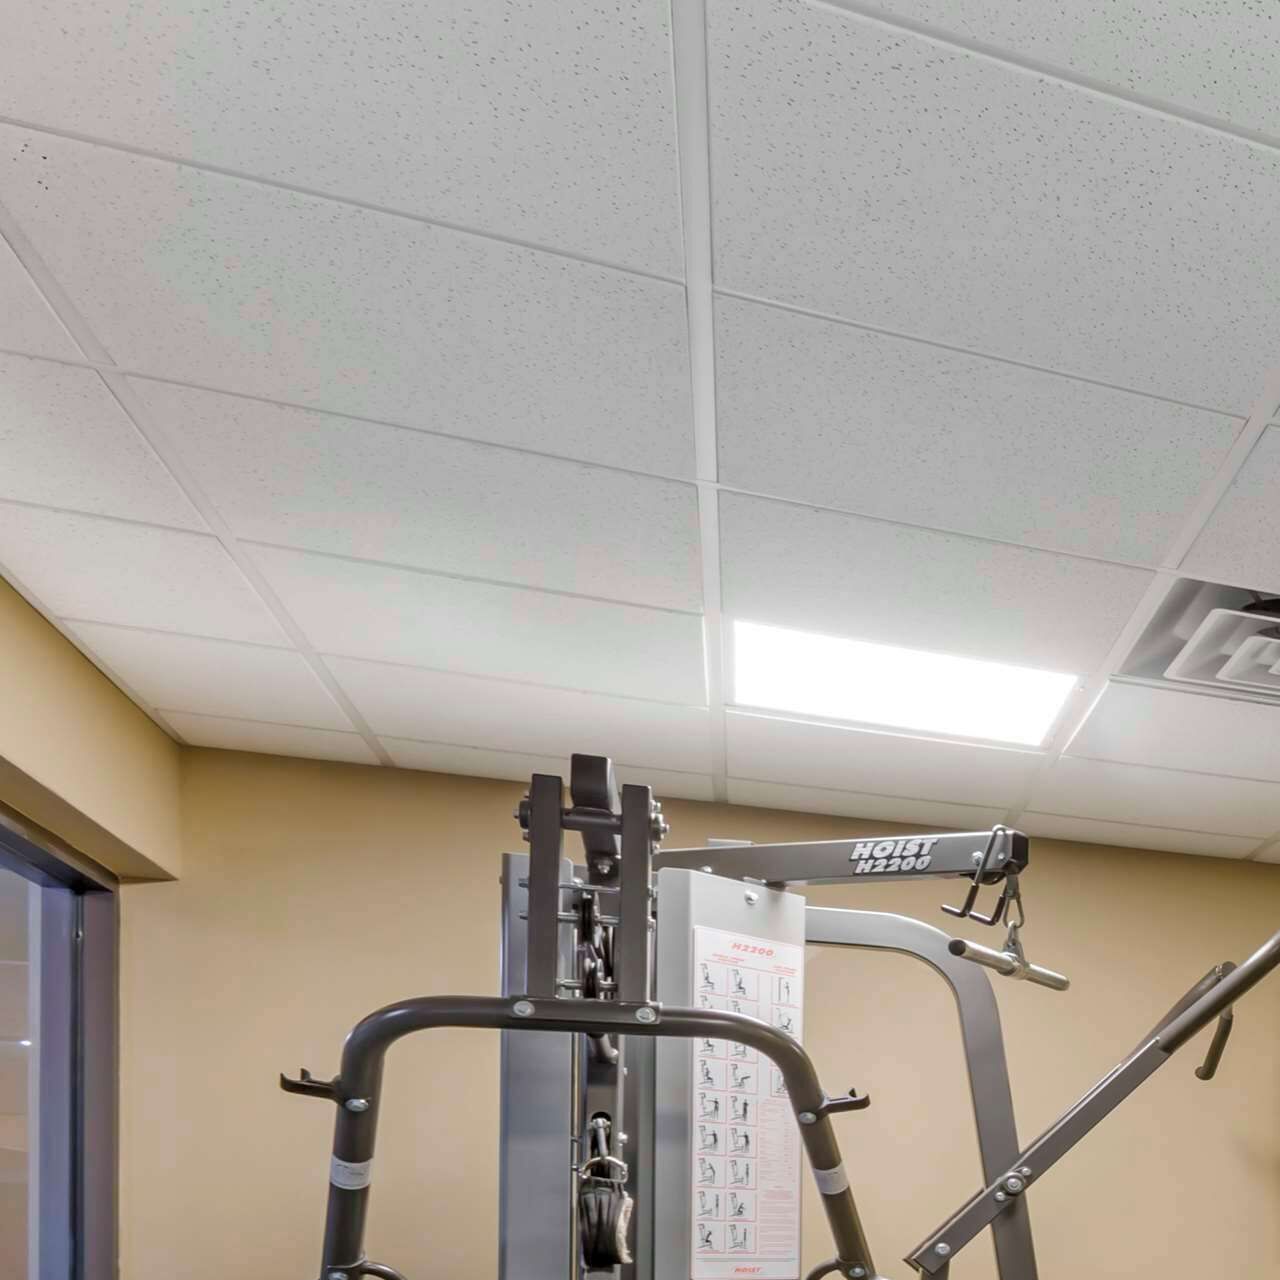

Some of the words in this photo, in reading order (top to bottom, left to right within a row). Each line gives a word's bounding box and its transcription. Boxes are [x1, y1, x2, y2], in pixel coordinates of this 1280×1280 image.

[850, 838, 939, 860] HOIST
[854, 855, 932, 874] H2200
[731, 943, 775, 957] H2200
